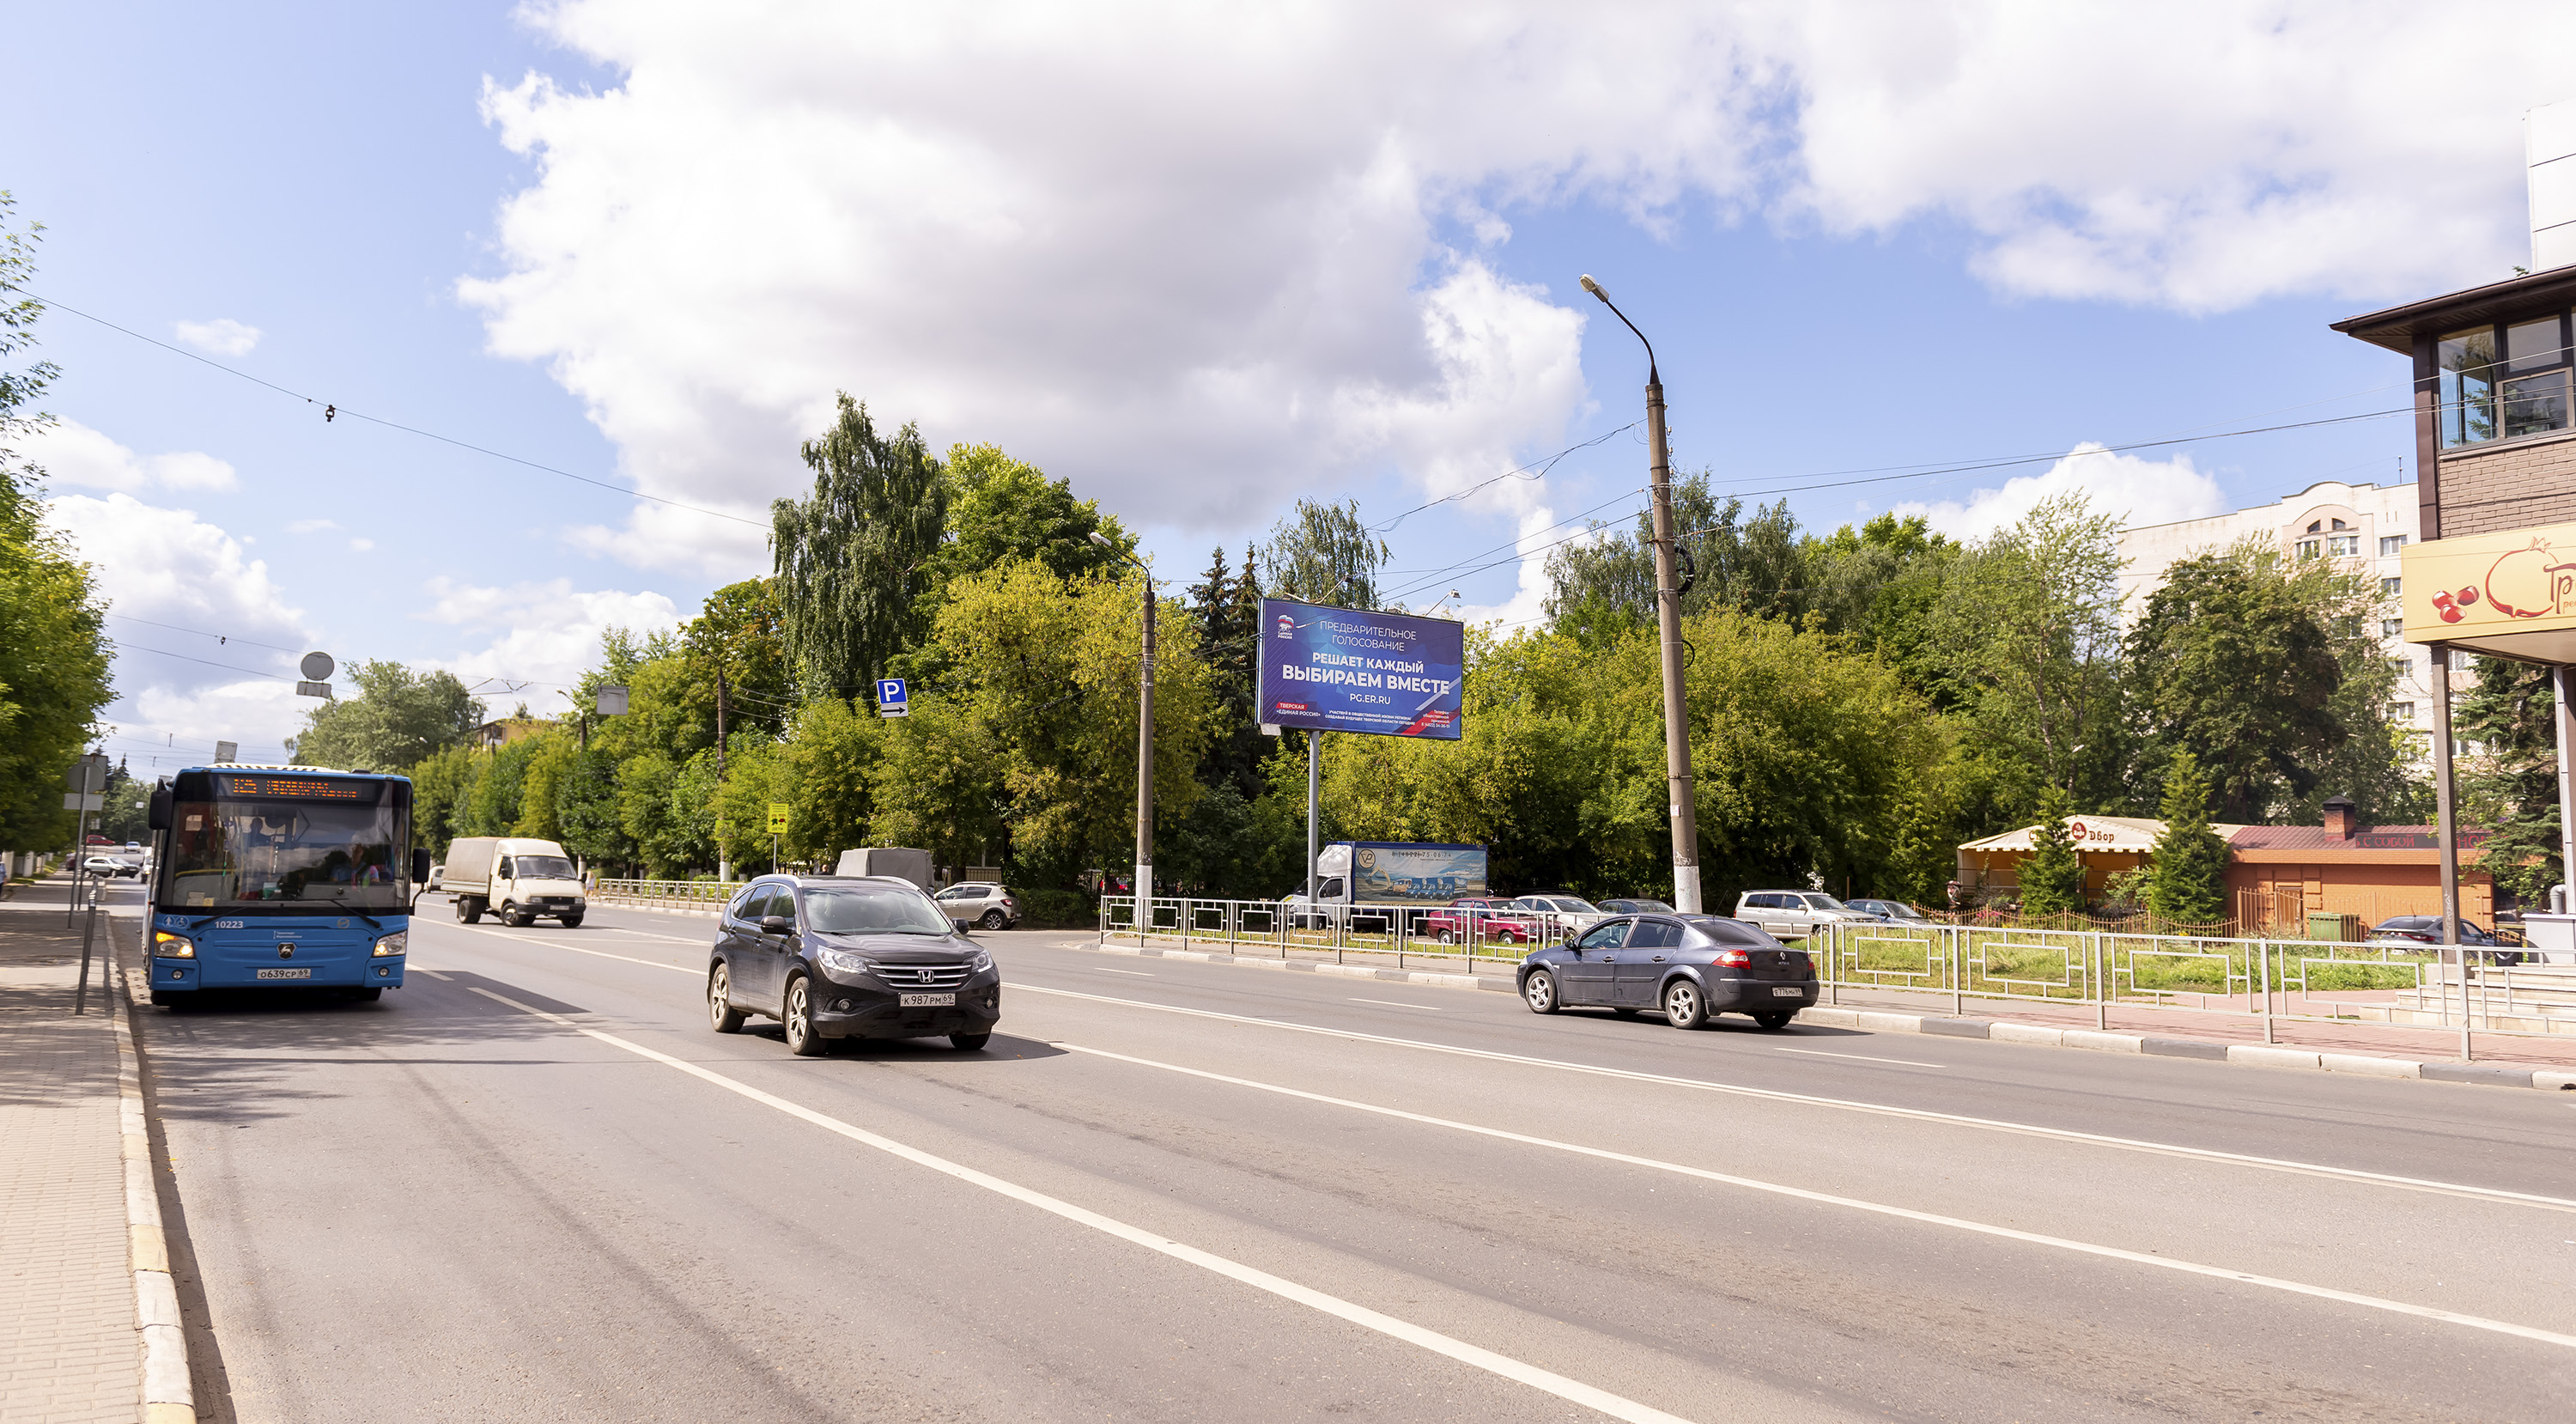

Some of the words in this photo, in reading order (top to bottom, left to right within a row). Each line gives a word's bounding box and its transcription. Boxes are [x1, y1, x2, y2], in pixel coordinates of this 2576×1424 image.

[1320, 620, 1417, 641] ПРЕДВАРИТЕЛЬНОЕ
[1332, 635, 1405, 652] ГОЛОСОВАНИЕ
[1312, 652, 1364, 667] РЕШАЕТ
[1366, 658, 1424, 673] КАЖДЫЙ
[1282, 664, 1382, 688] ВЫБИРАЕМ
[1387, 674, 1450, 695] ВМЕСТЕ
[1350, 693, 1391, 704] PG.ER.RU
